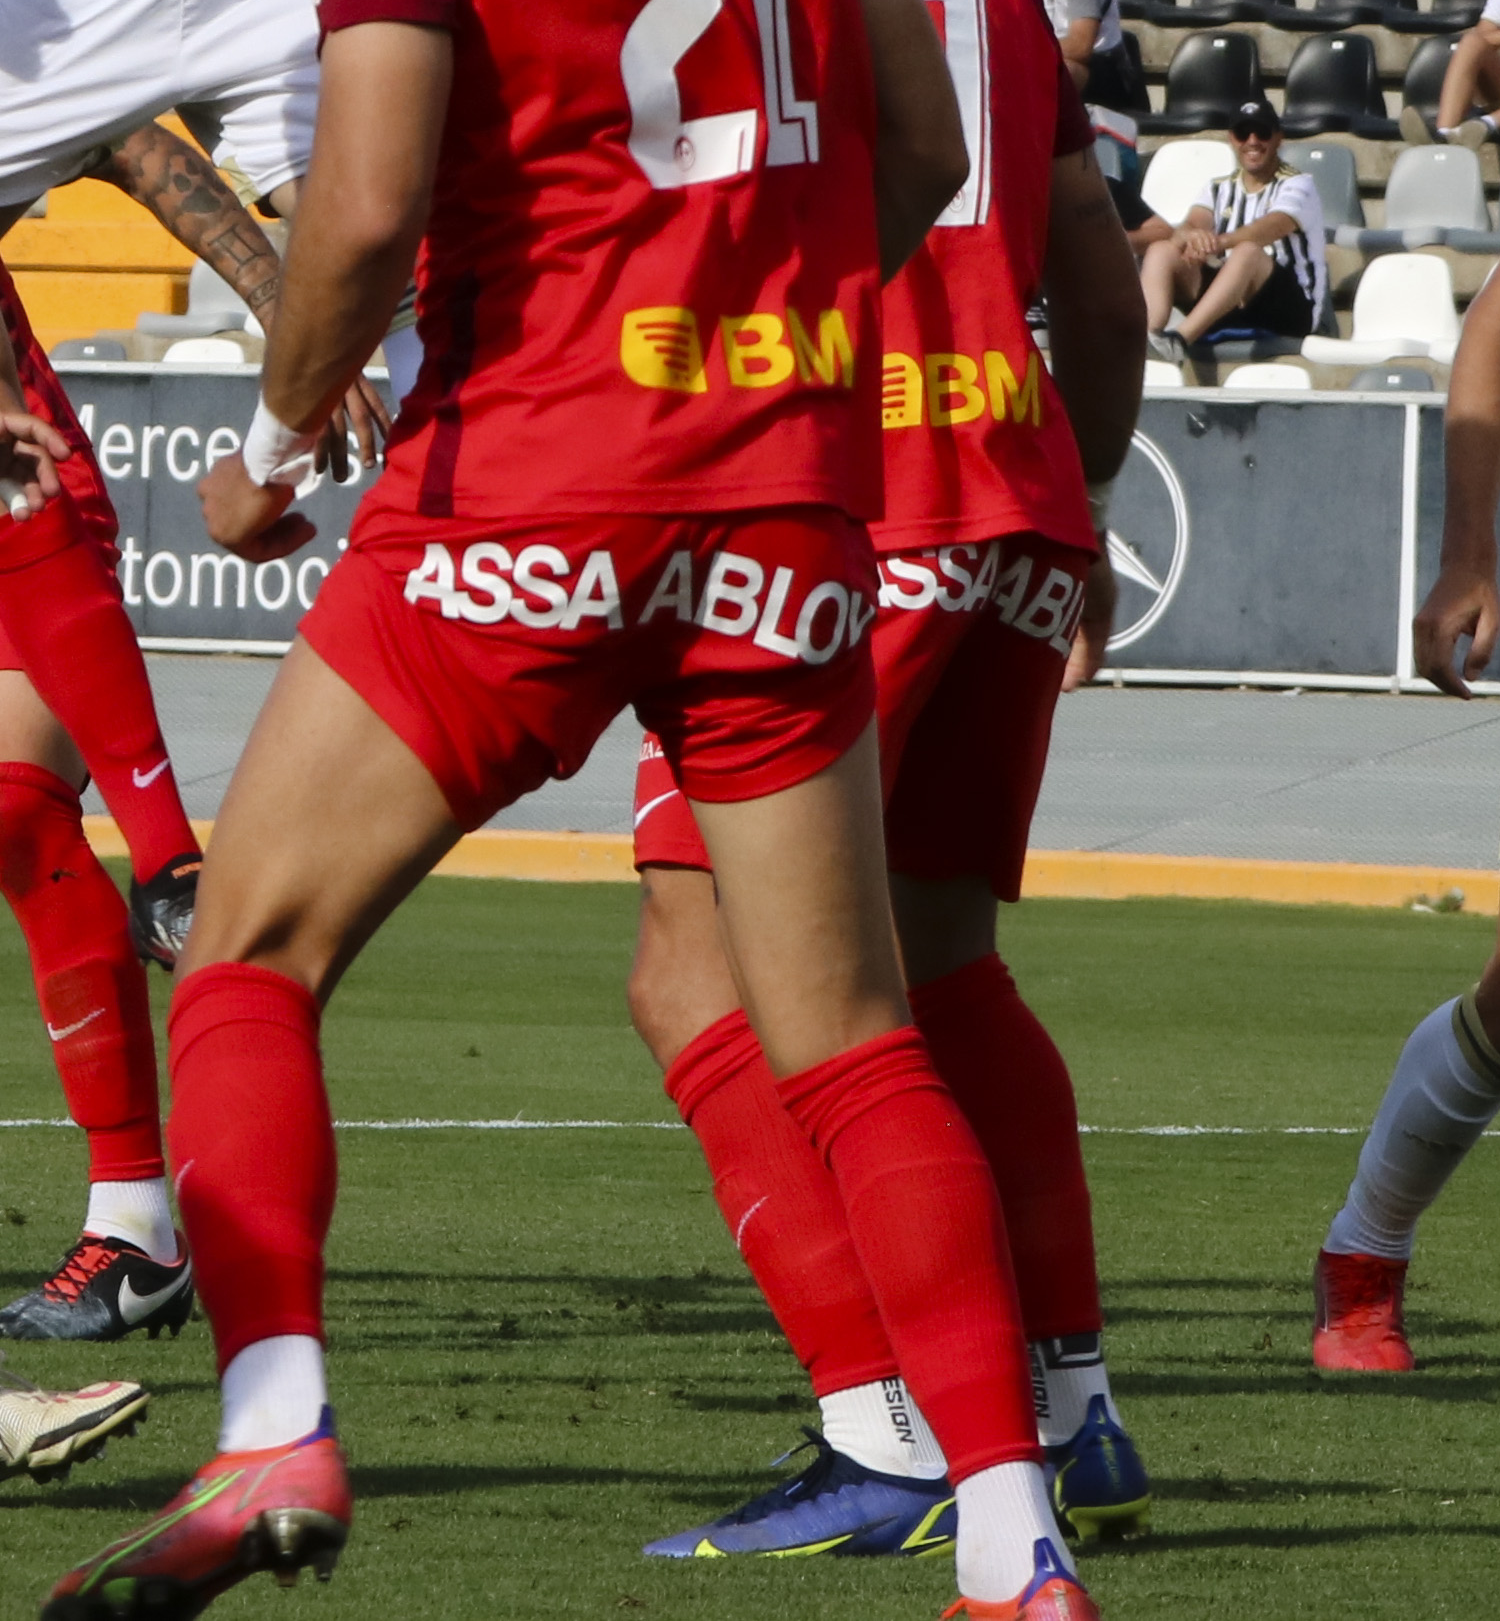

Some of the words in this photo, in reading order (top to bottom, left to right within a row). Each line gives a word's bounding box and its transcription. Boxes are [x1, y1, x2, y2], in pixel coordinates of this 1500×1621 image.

[720, 309, 855, 389] BM
[923, 350, 1043, 428] BM
[403, 541, 624, 632] ASSA
